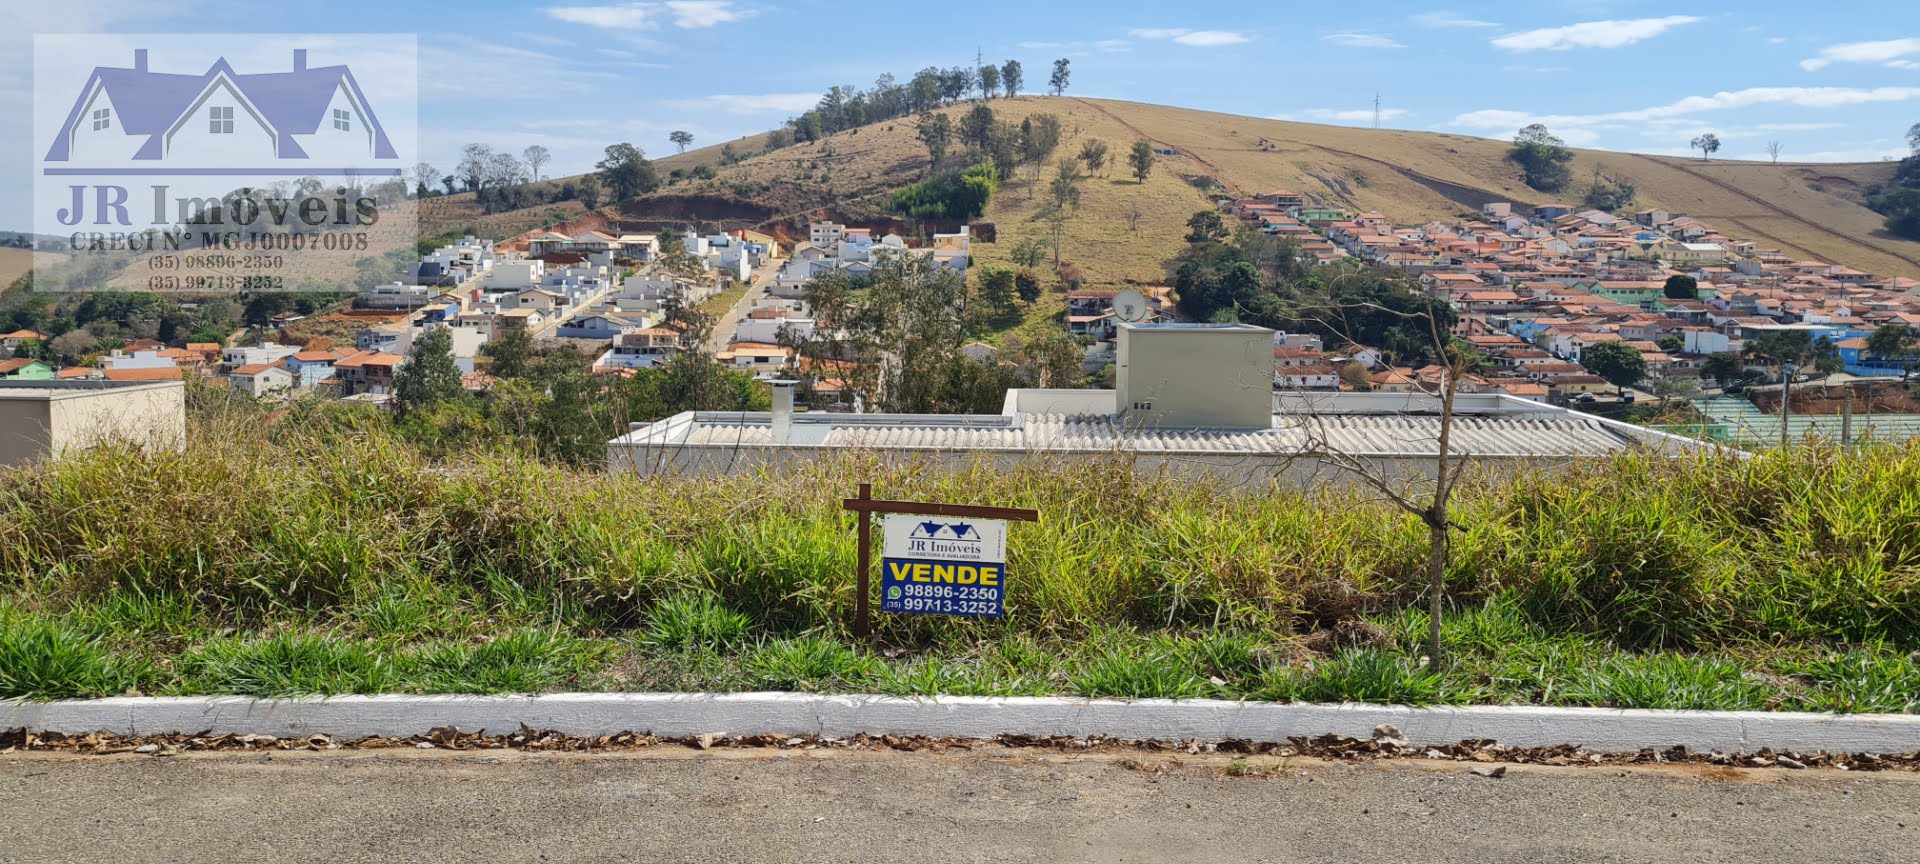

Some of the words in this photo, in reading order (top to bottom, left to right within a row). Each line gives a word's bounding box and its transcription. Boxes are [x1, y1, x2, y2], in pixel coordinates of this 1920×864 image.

[908, 540, 926, 551] JR
[931, 541, 981, 554] Imóveis
[889, 562, 998, 586] VENDE
[904, 584, 998, 600] 98896-2350
[887, 601, 901, 609] (35)
[904, 598, 997, 614] 99713-3252
